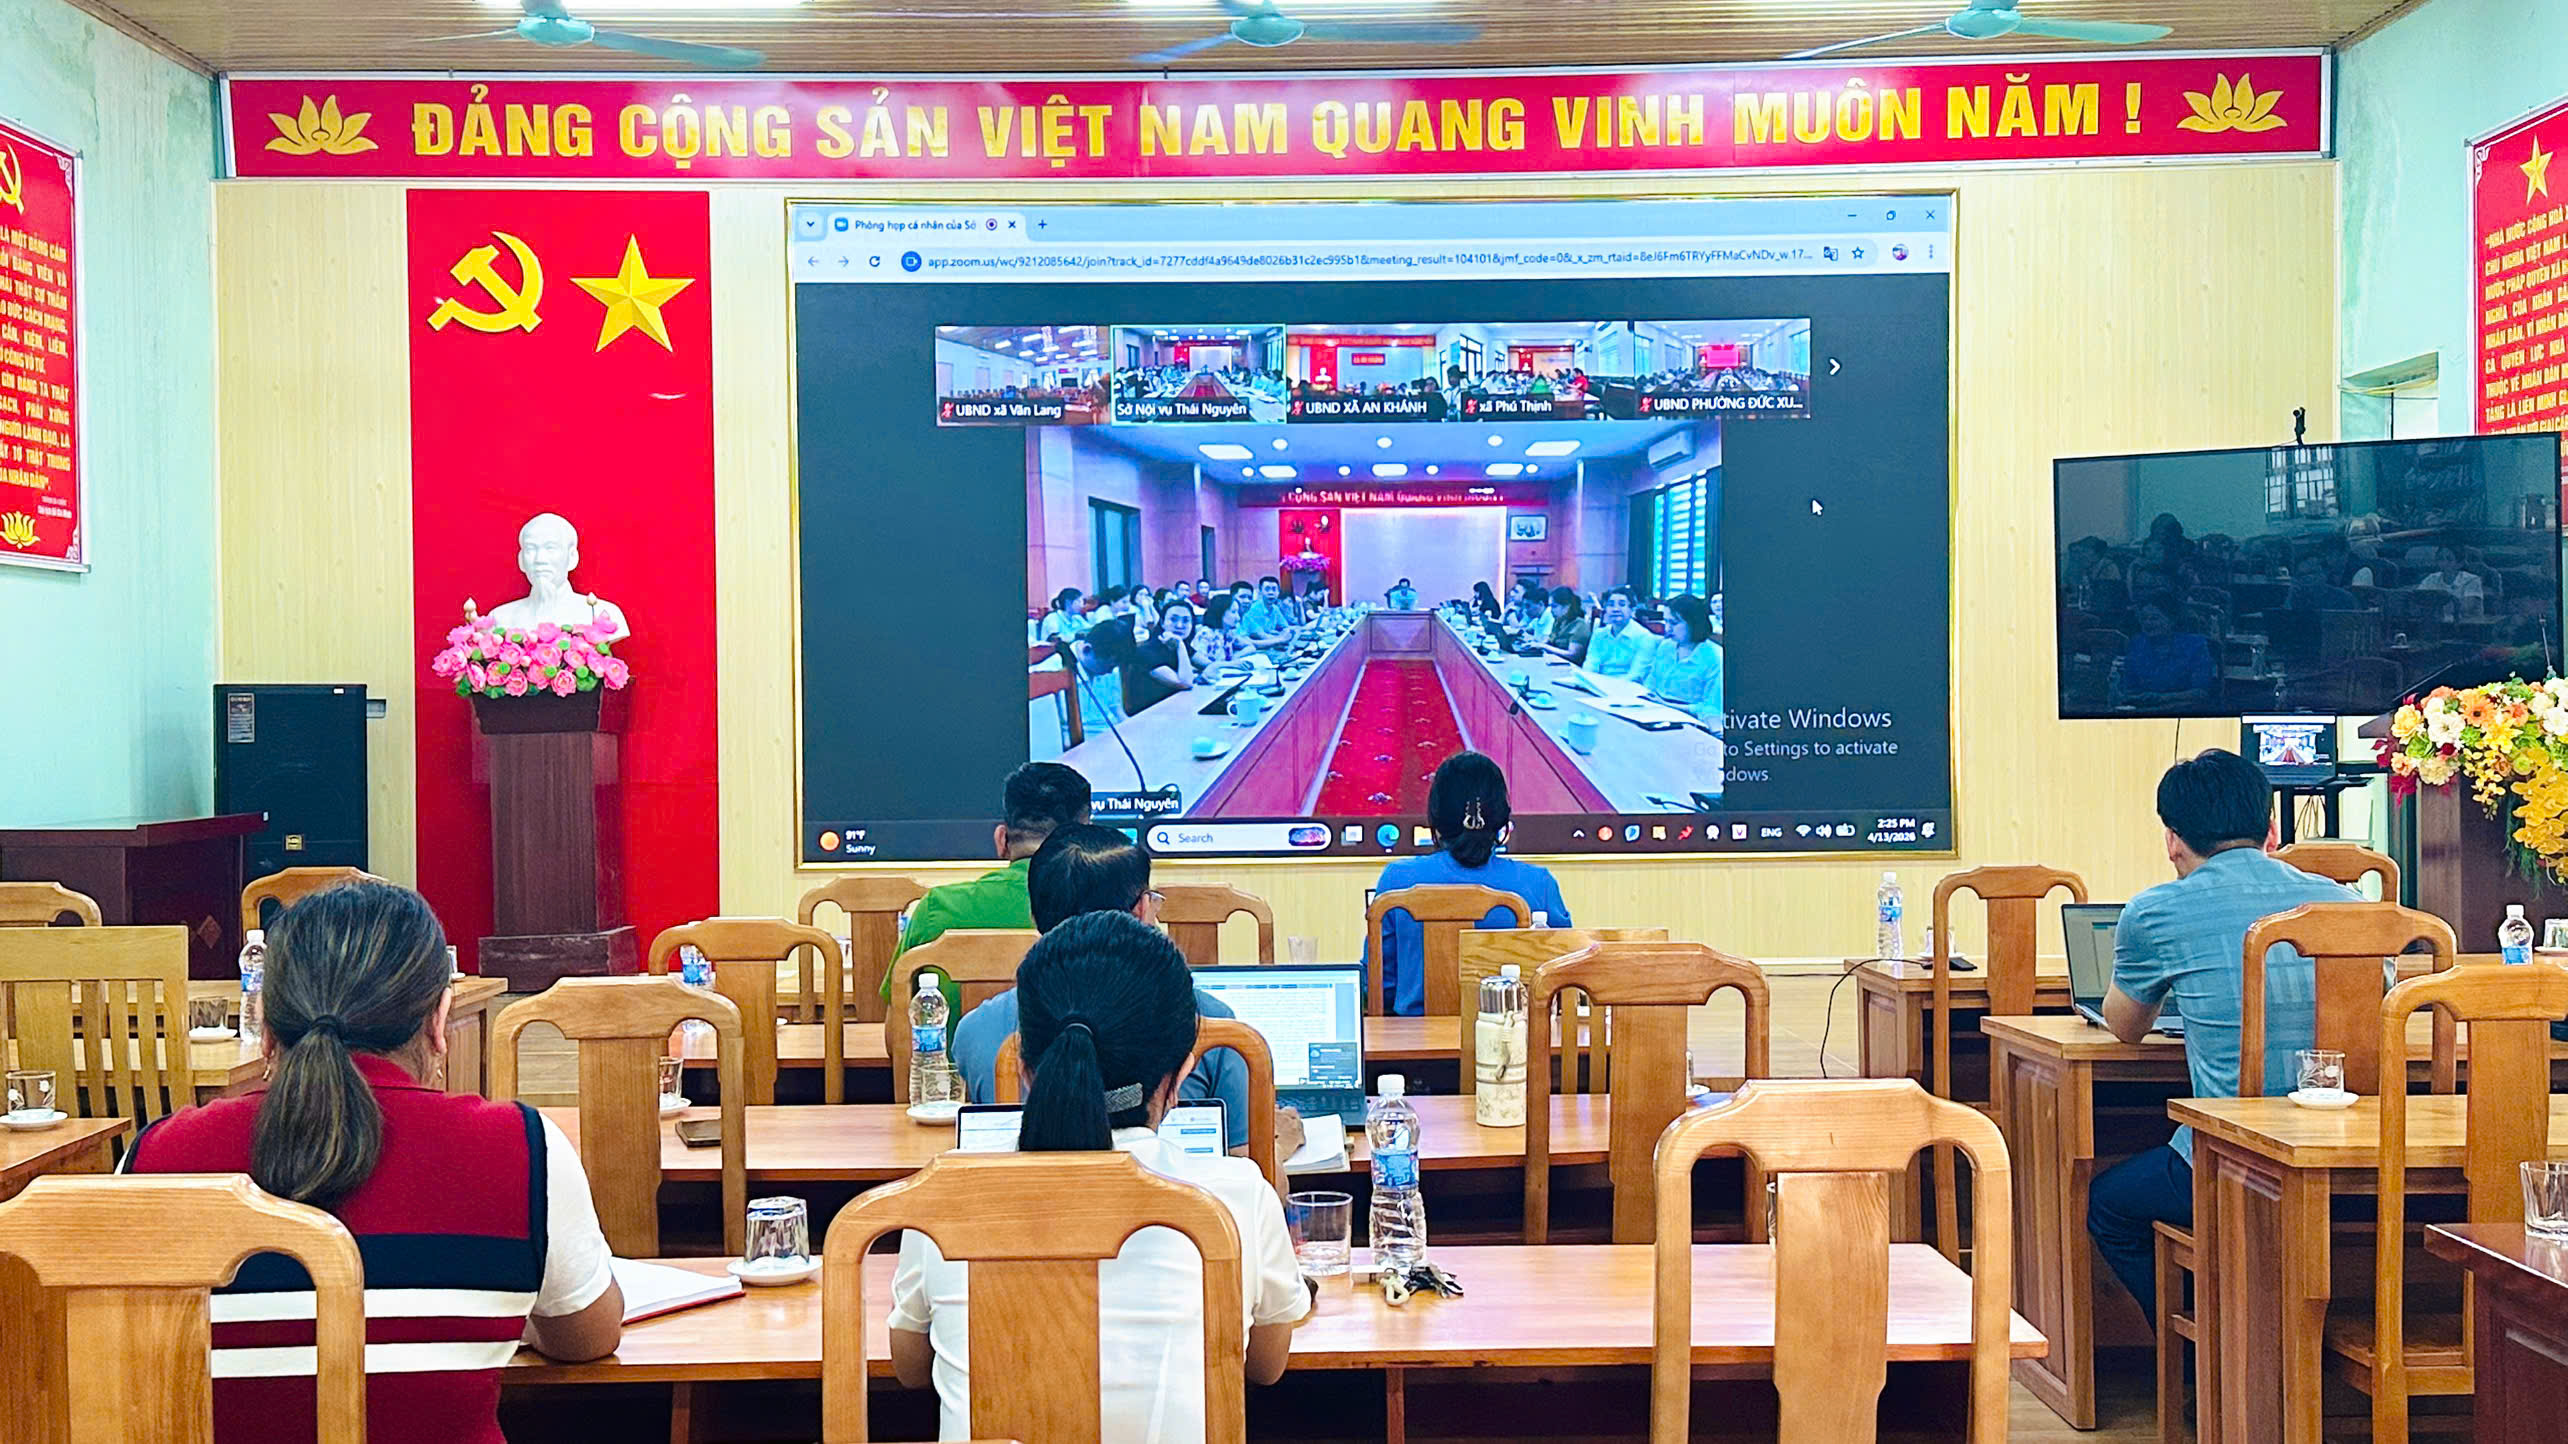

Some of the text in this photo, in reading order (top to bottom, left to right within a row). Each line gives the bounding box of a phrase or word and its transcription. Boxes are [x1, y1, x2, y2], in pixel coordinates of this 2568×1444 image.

[412, 73, 2142, 170] ĐẢNG CỘNG SẢN VIỆT NAM QUANG VINH MUÔN NĂM !
[1306, 399, 1427, 414] UBND XÃ AN KHÁNH
[1479, 400, 1552, 413] xã Phú Thịnh
[1654, 398, 1689, 410] UBND
[1692, 395, 1745, 410] PHƯỜNG
[1748, 394, 1775, 409] ĐỨC
[956, 404, 1061, 419] UBND xã Văn Lang
[1117, 403, 1247, 417] Sở Nội vụ Thái Nguyên
[1723, 707, 1892, 729] tivate Windows
[1744, 741, 1809, 760] Settings
[1814, 742, 1831, 755] to
[1835, 741, 1898, 755] activate
[1107, 798, 1131, 809] Thái
[1134, 797, 1178, 812] Nguyên
[1899, 818, 1915, 828] PM
[1178, 833, 1214, 843] Search
[1760, 828, 1783, 837] ENG
[845, 844, 876, 855] Sunny
